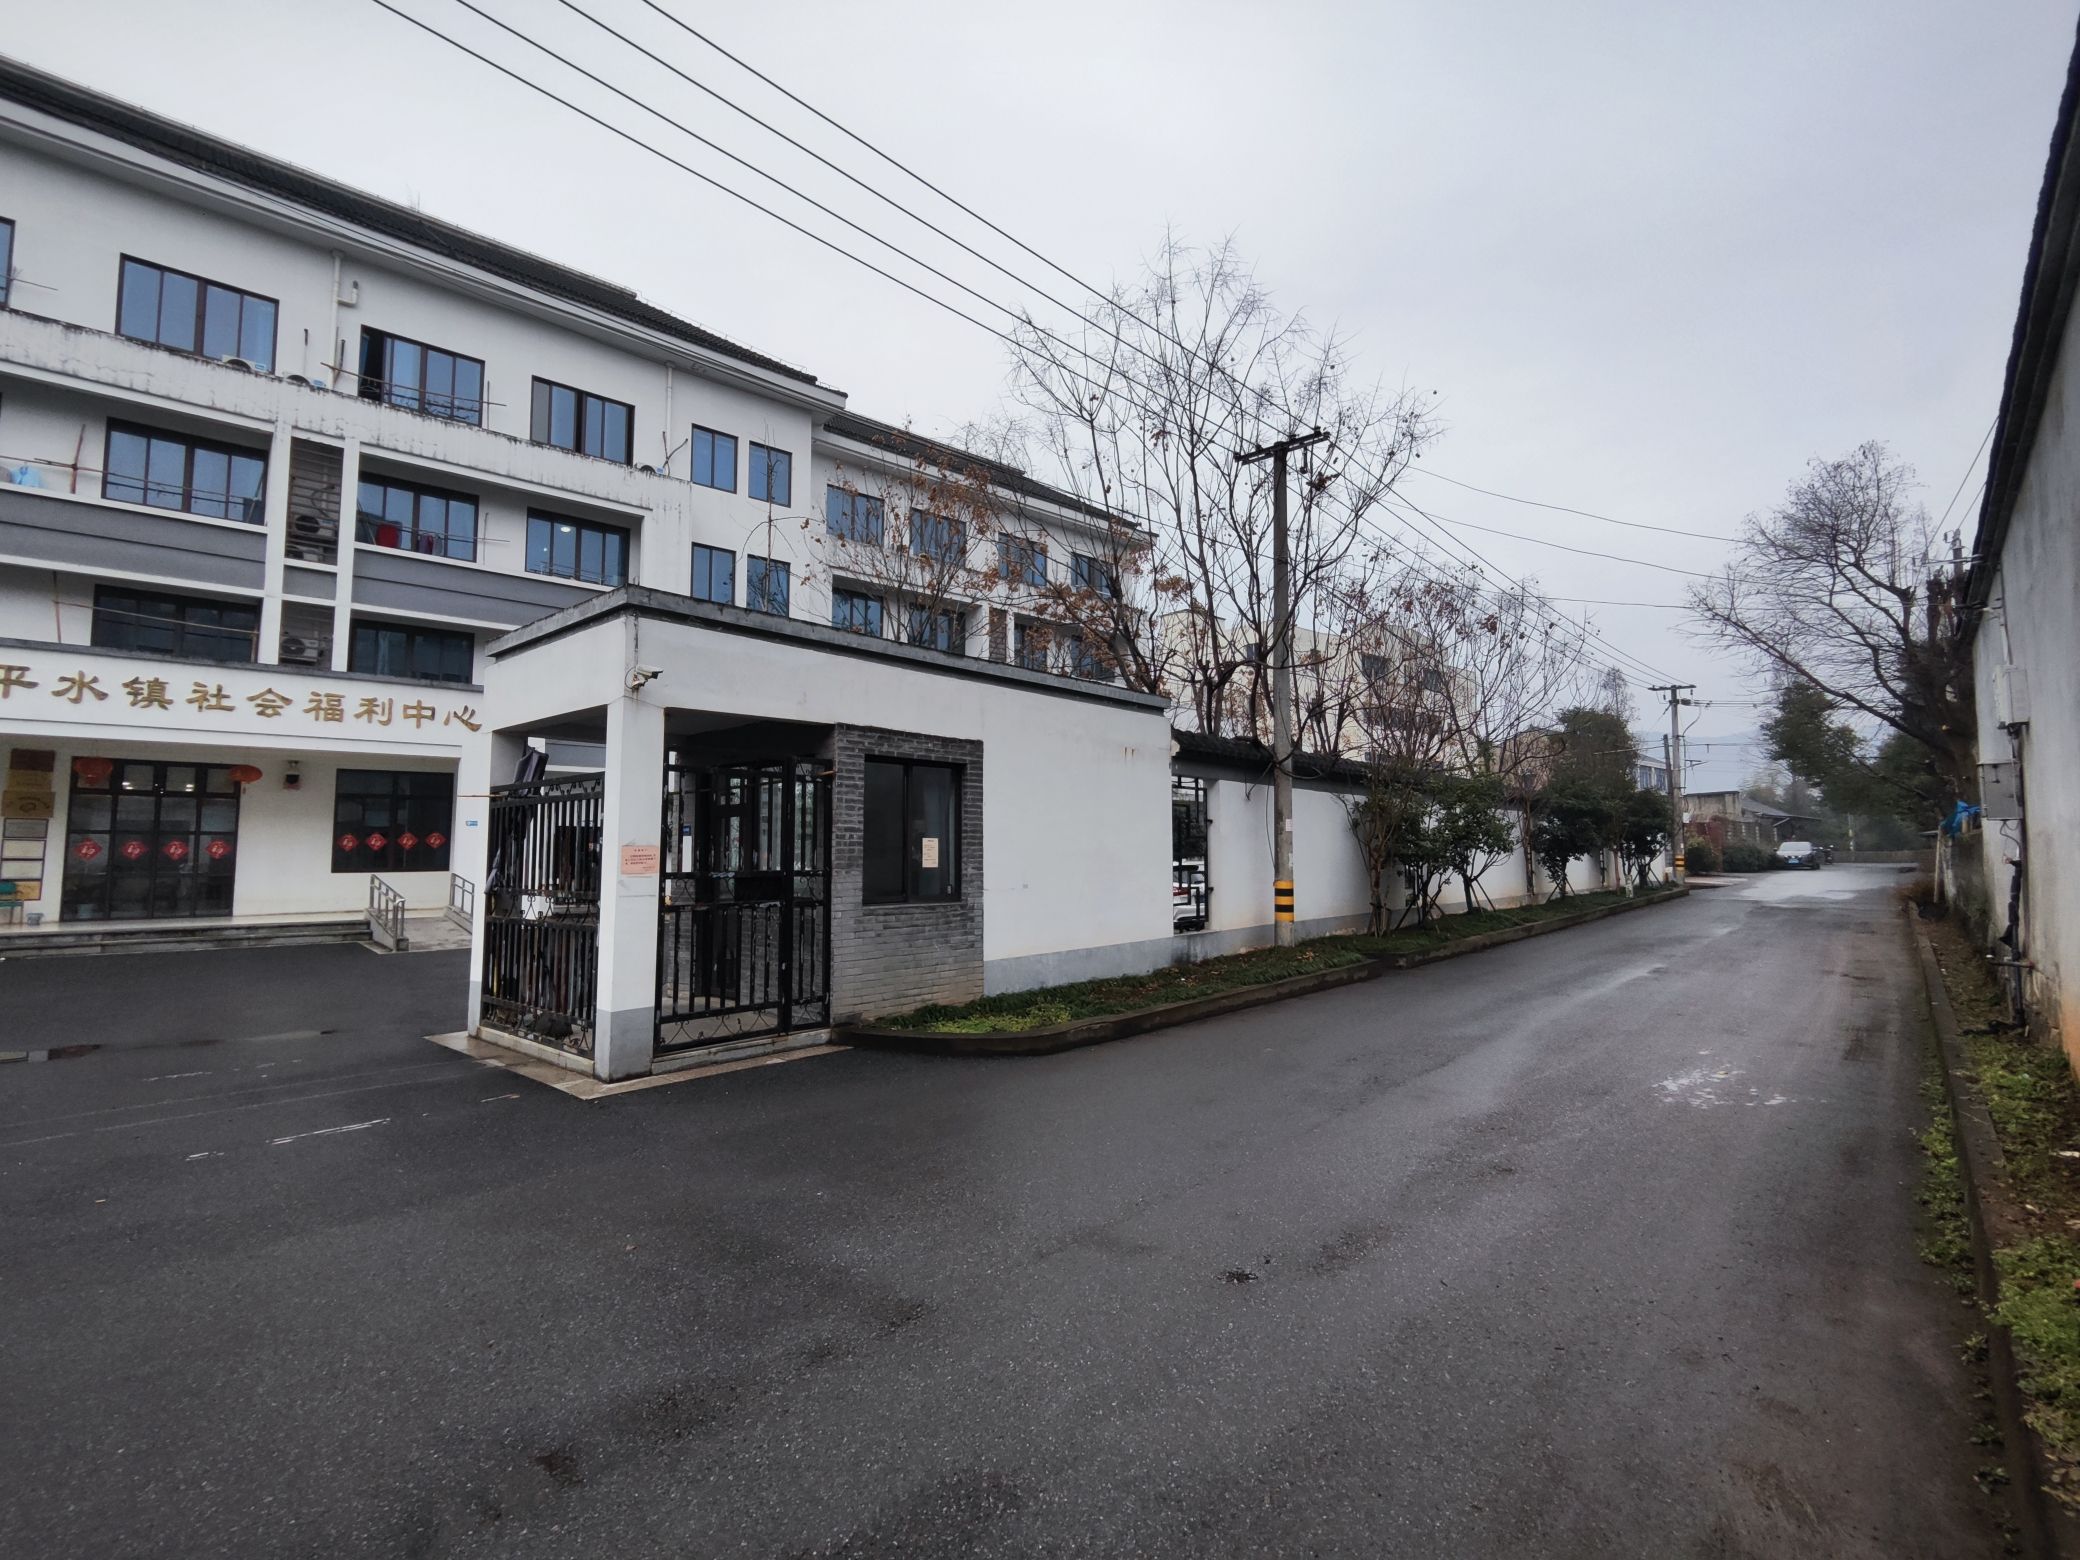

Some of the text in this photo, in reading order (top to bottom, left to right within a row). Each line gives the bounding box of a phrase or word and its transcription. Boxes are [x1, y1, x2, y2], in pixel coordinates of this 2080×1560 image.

[0, 664, 483, 732] 平水镇社会福利中心
